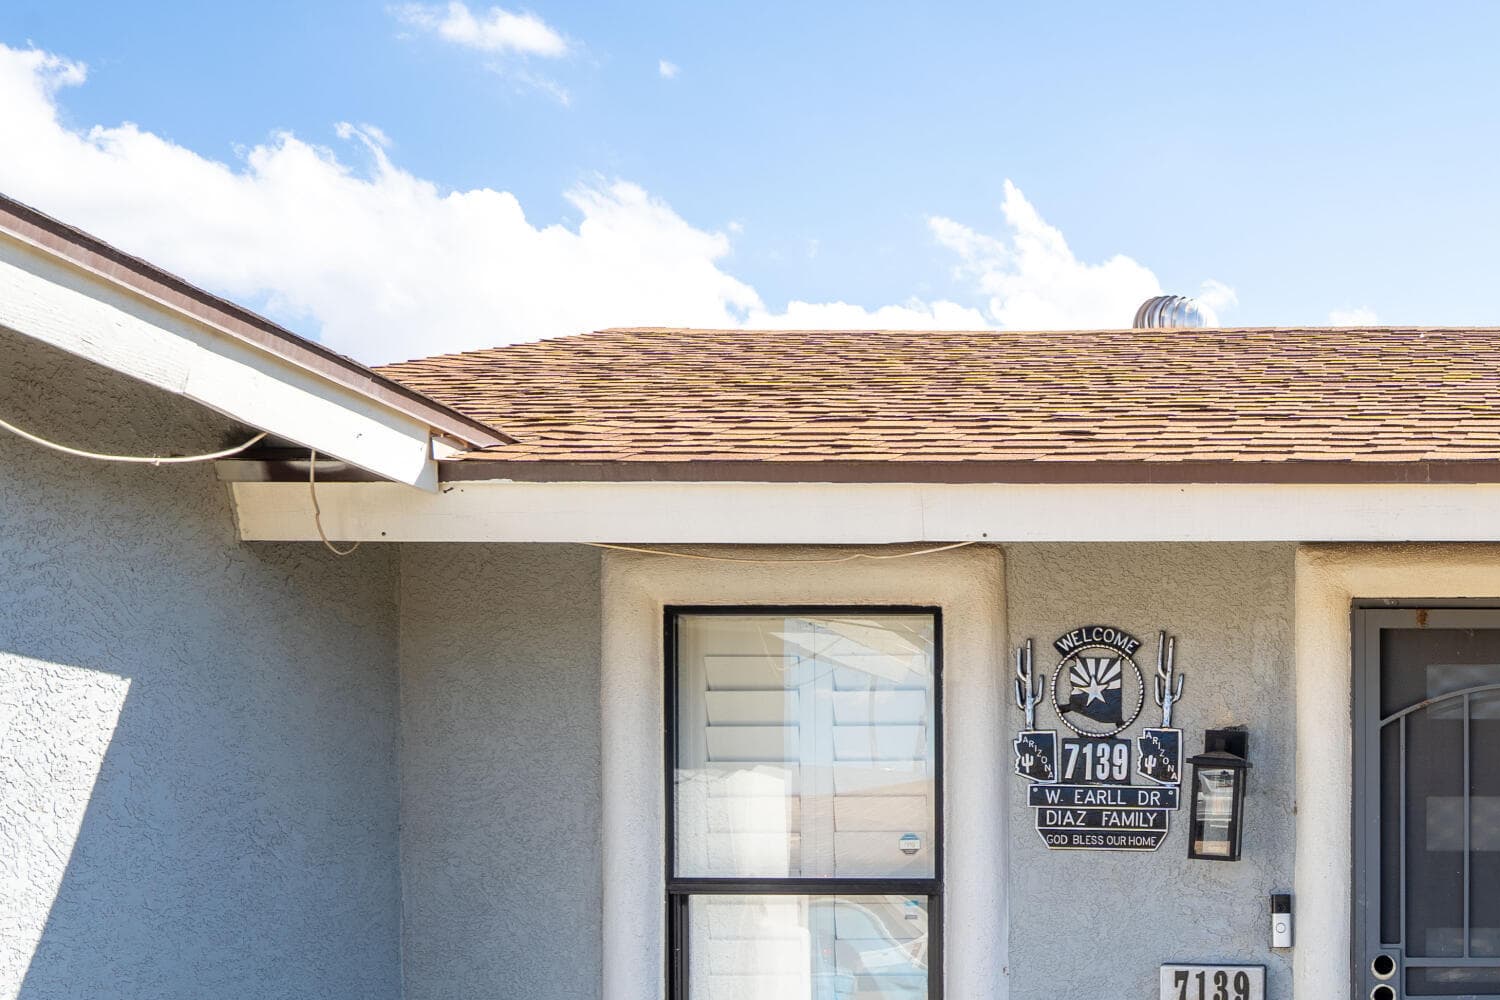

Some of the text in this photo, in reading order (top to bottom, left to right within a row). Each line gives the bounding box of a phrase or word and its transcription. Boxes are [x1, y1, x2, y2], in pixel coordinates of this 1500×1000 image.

[1056, 627, 1140, 654] WELCOME
[1022, 735, 1054, 779] ARIZONA
[1064, 743, 1128, 780] 7139
[1146, 731, 1178, 780] ARIZONA
[1074, 789, 1127, 805] EARLL
[1046, 810, 1157, 827] DIAZ FAMILY
[1046, 834, 1157, 847] GOD BLESS OUR HOME
